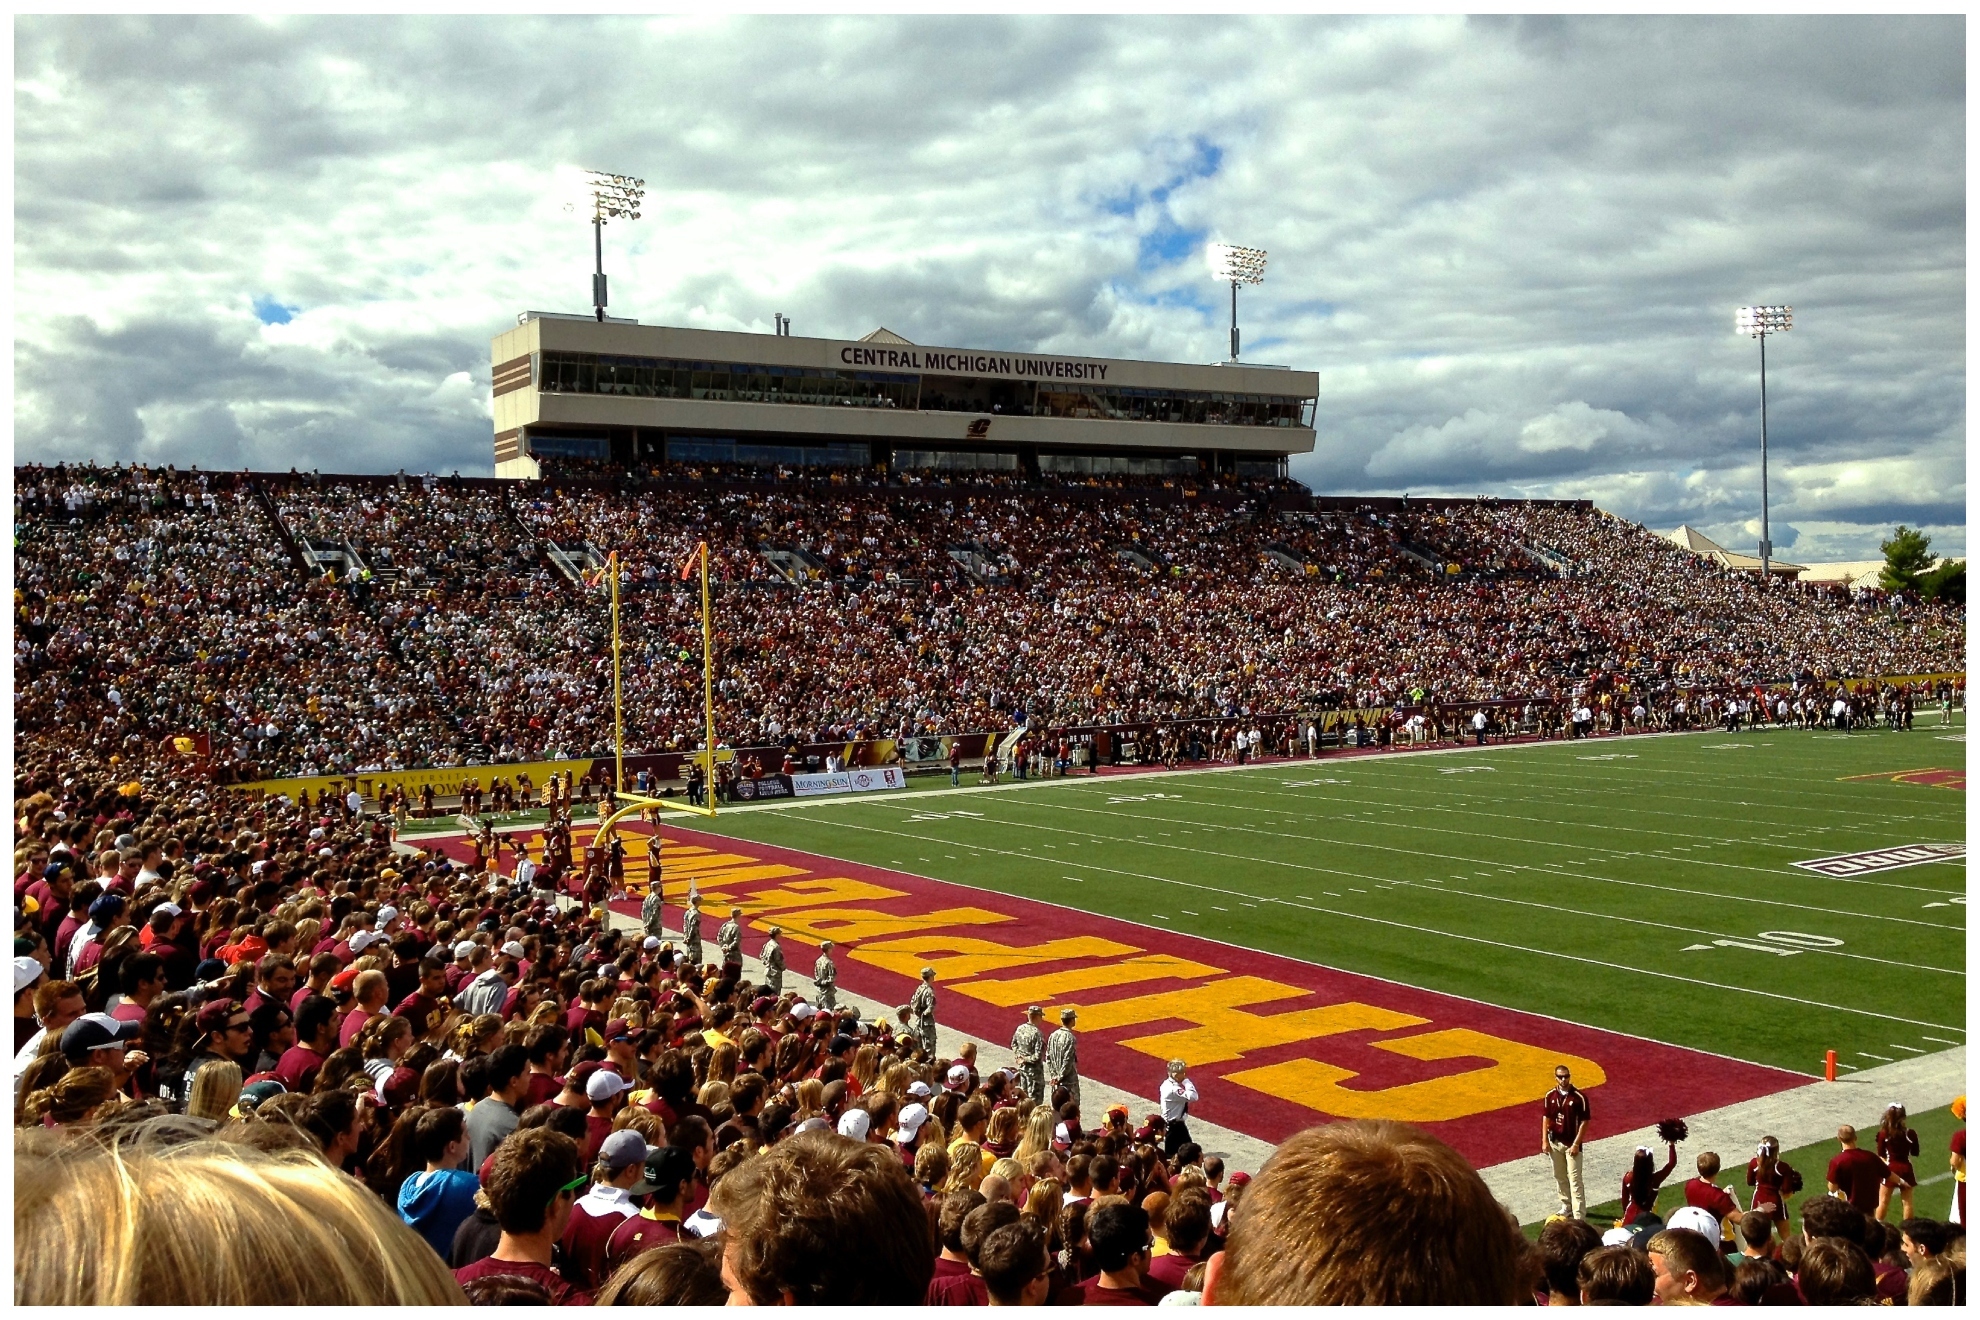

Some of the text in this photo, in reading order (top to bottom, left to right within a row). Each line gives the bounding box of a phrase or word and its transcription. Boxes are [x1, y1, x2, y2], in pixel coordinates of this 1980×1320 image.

[840, 347, 1108, 380] CENTRAL MICHIGAN UNIVERSITY
[381, 773, 469, 784] UNIVERSITY
[795, 779, 832, 789] MORNING
[832, 778, 848, 786] SUN
[391, 782, 463, 798] ADOW
[1712, 930, 1845, 957] 10
